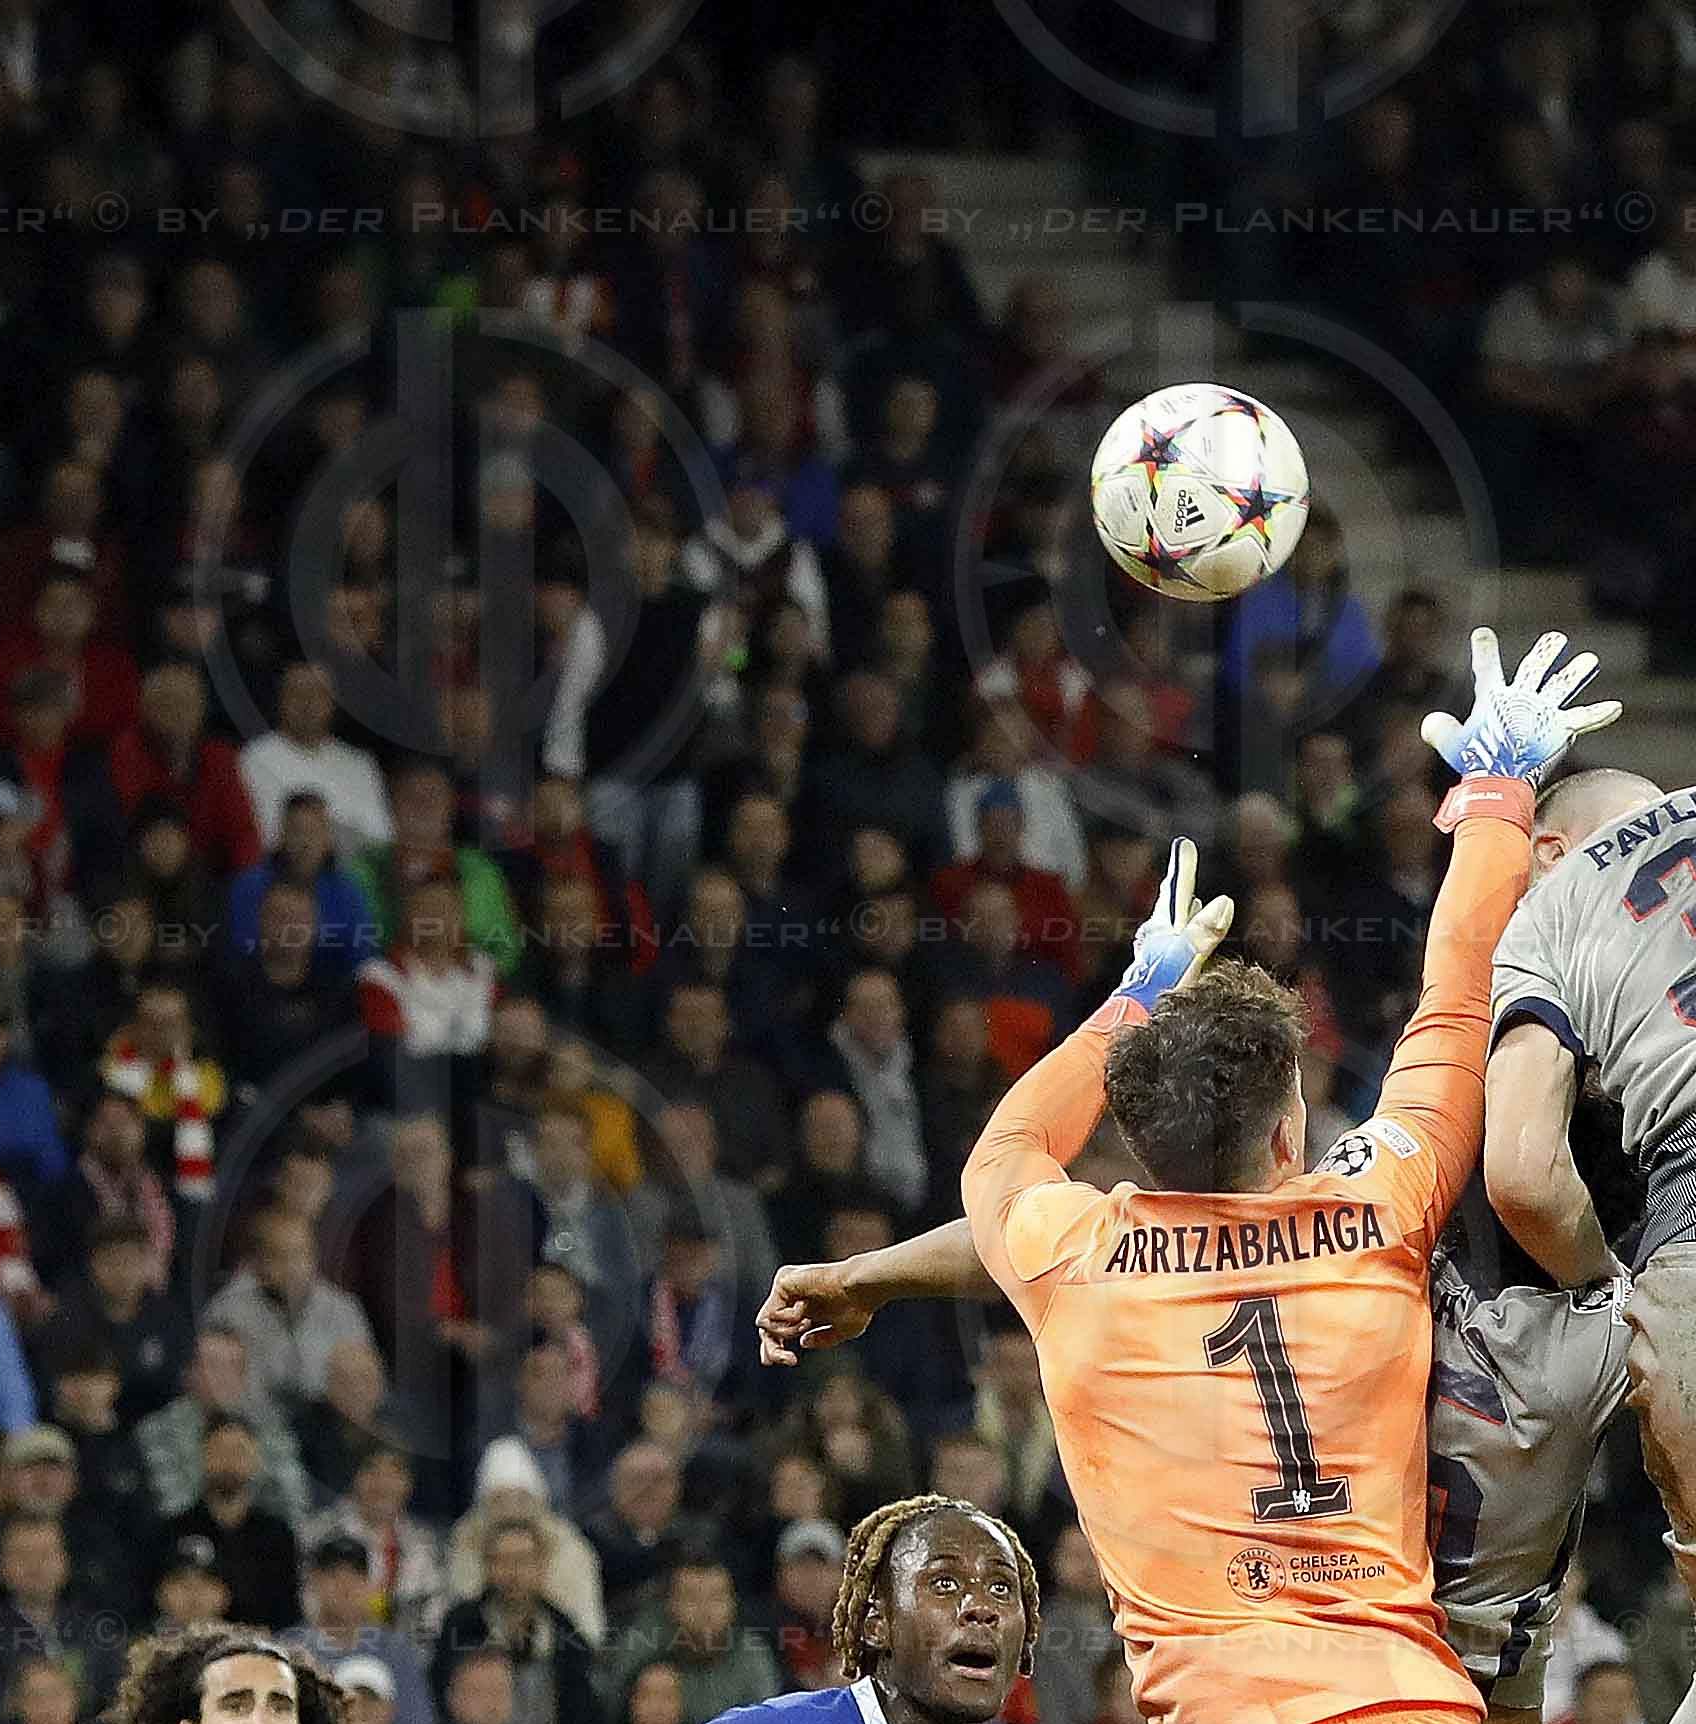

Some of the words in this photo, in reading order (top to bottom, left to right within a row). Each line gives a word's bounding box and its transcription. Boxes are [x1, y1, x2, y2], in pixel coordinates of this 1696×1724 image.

[1174, 489, 1187, 534] adidas
[1105, 1203, 1385, 1273] ARRIZABALAGA
[1203, 1296, 1351, 1523] 1
[1290, 1553, 1359, 1570] CHELSEA
[1292, 1565, 1385, 1583] FOUNDATION
